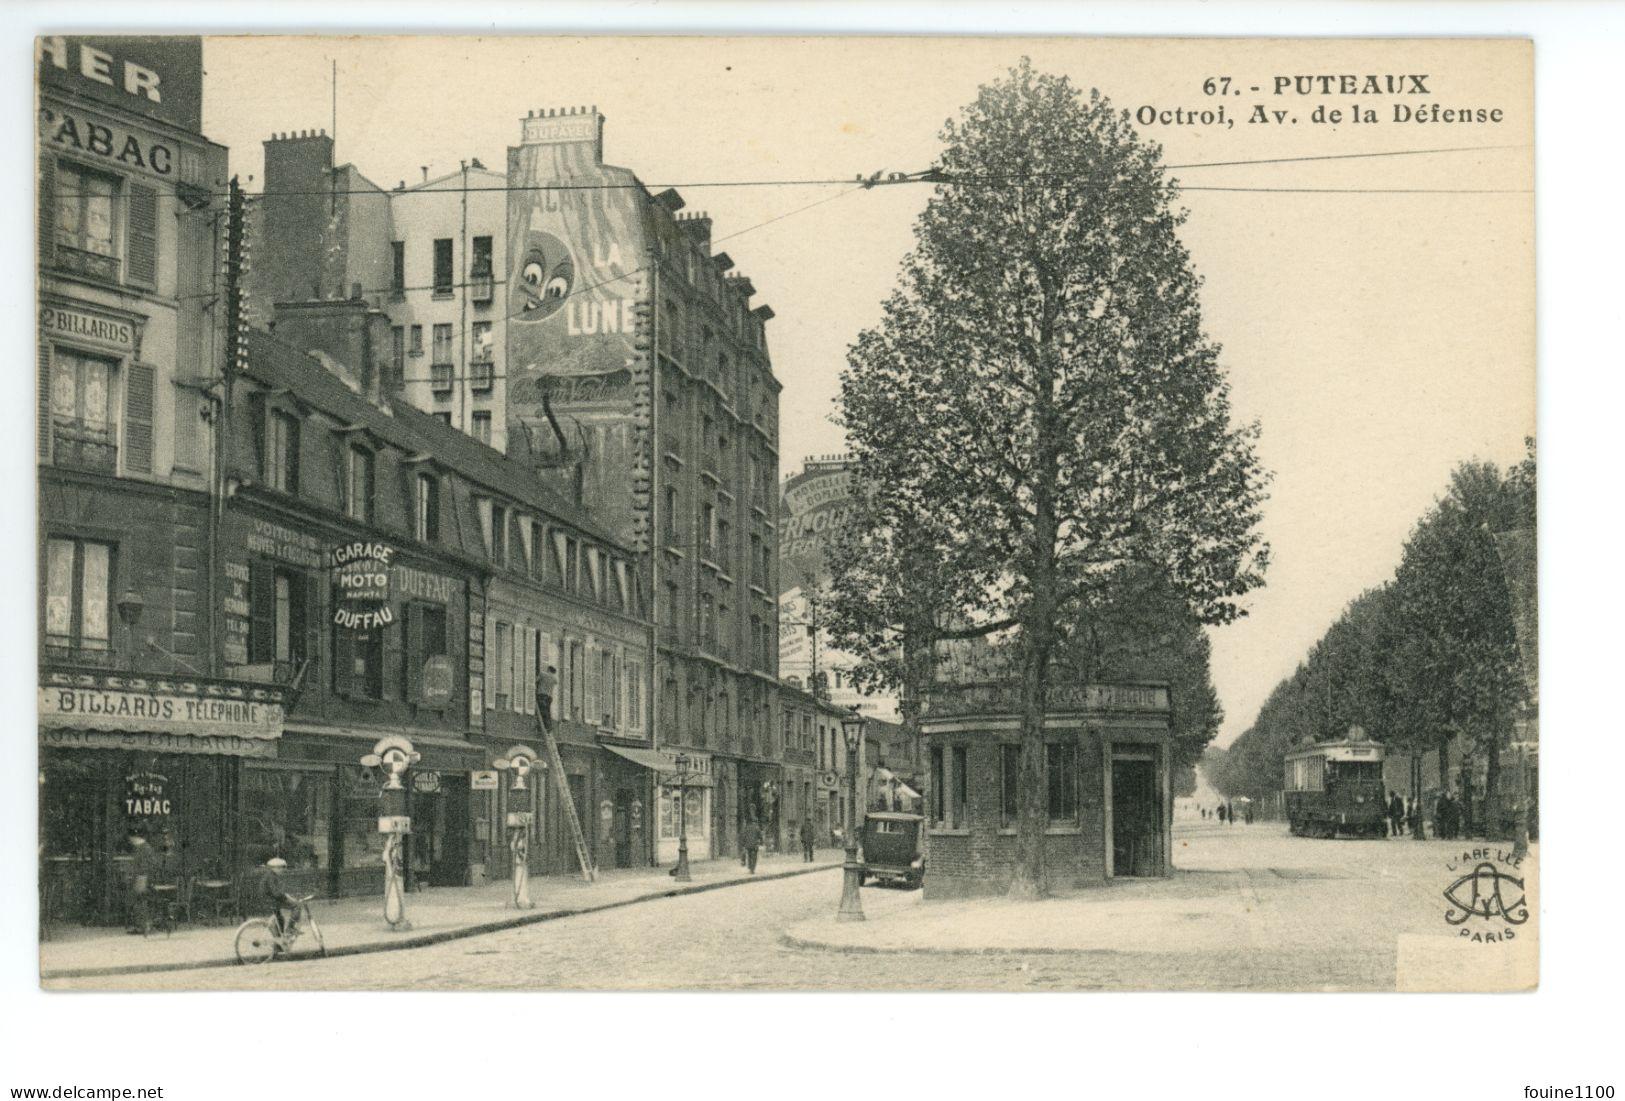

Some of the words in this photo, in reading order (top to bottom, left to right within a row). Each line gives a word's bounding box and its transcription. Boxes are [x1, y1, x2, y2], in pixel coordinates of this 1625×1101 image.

[594, 243, 622, 268] LA
[43, 309, 54, 329] 2
[58, 311, 128, 343] BILLARDS
[568, 300, 635, 335] LUNE
[335, 542, 393, 565] GARAGE
[341, 573, 387, 588] MOTO
[400, 565, 450, 602] DUFFAU
[334, 606, 393, 629] DUFFAU
[58, 690, 173, 719] BILLARDS
[126, 799, 170, 815] TABAC
